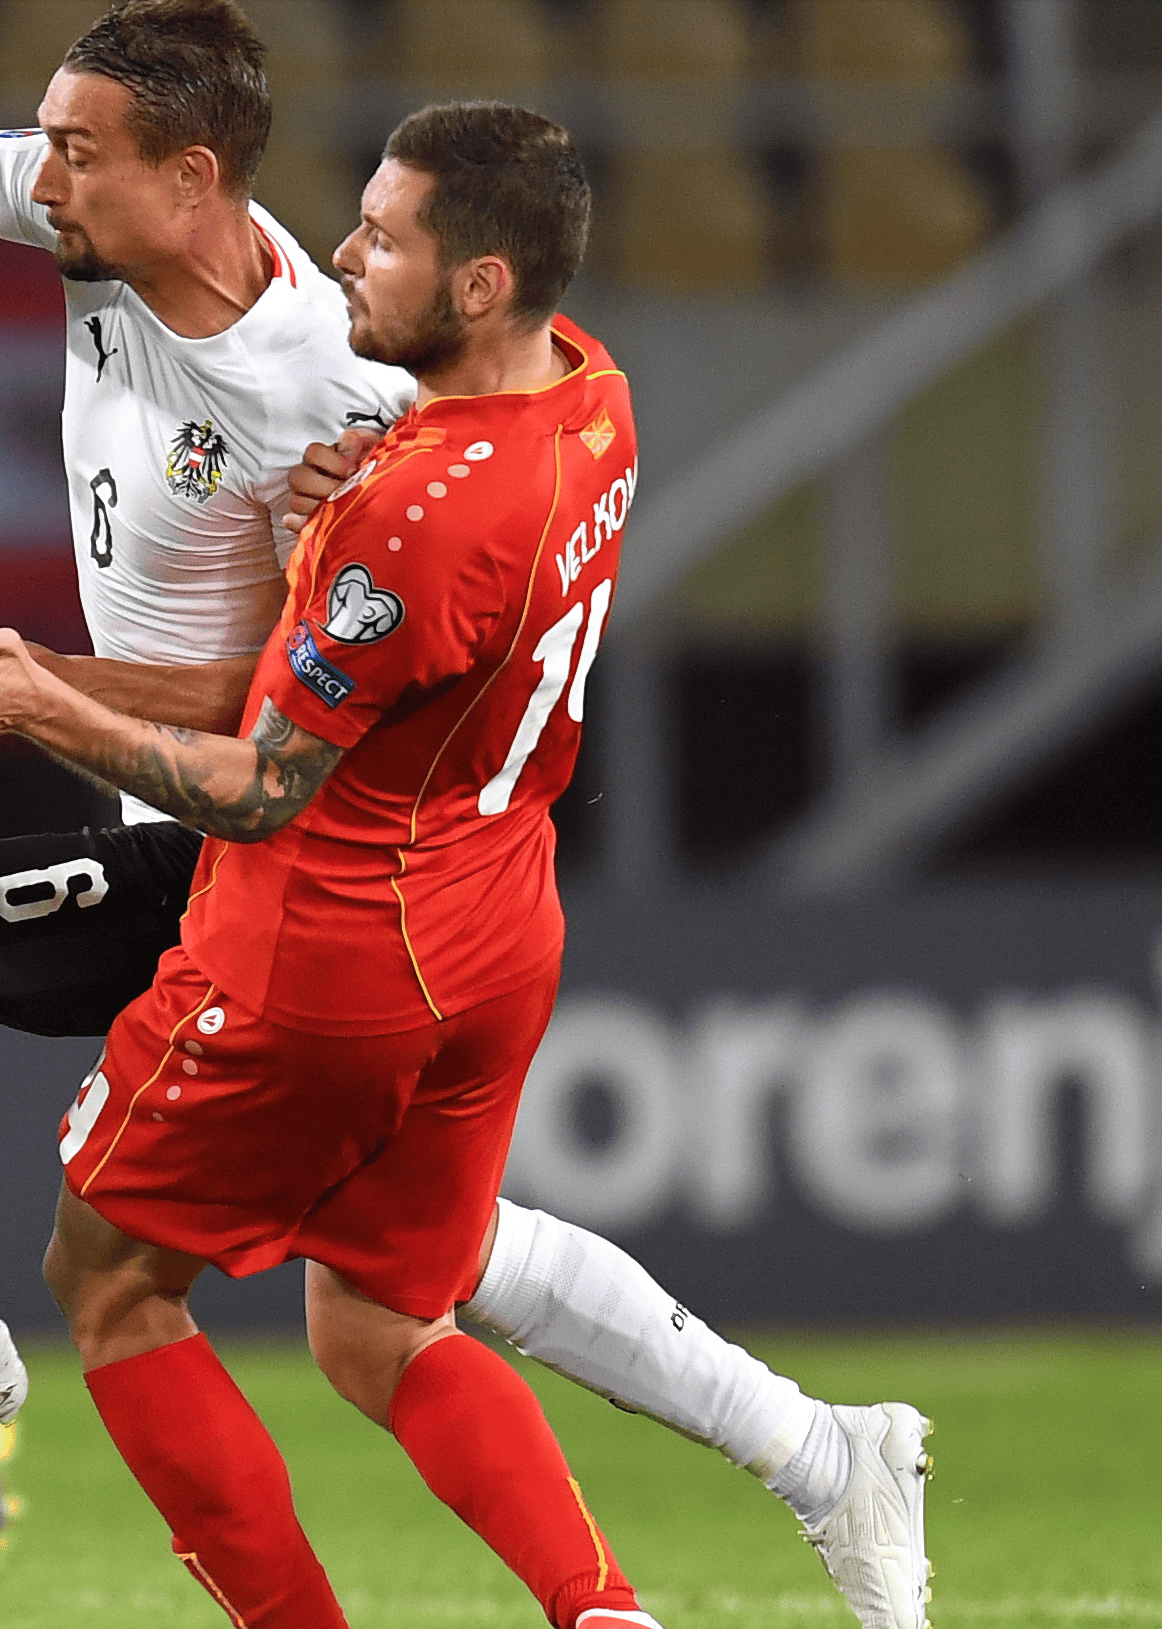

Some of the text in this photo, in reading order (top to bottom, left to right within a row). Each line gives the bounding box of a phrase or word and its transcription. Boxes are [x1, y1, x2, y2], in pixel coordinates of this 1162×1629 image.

[90, 467, 118, 568] 6
[296, 643, 349, 699] RESPECT
[506, 968, 1162, 1265] oren
